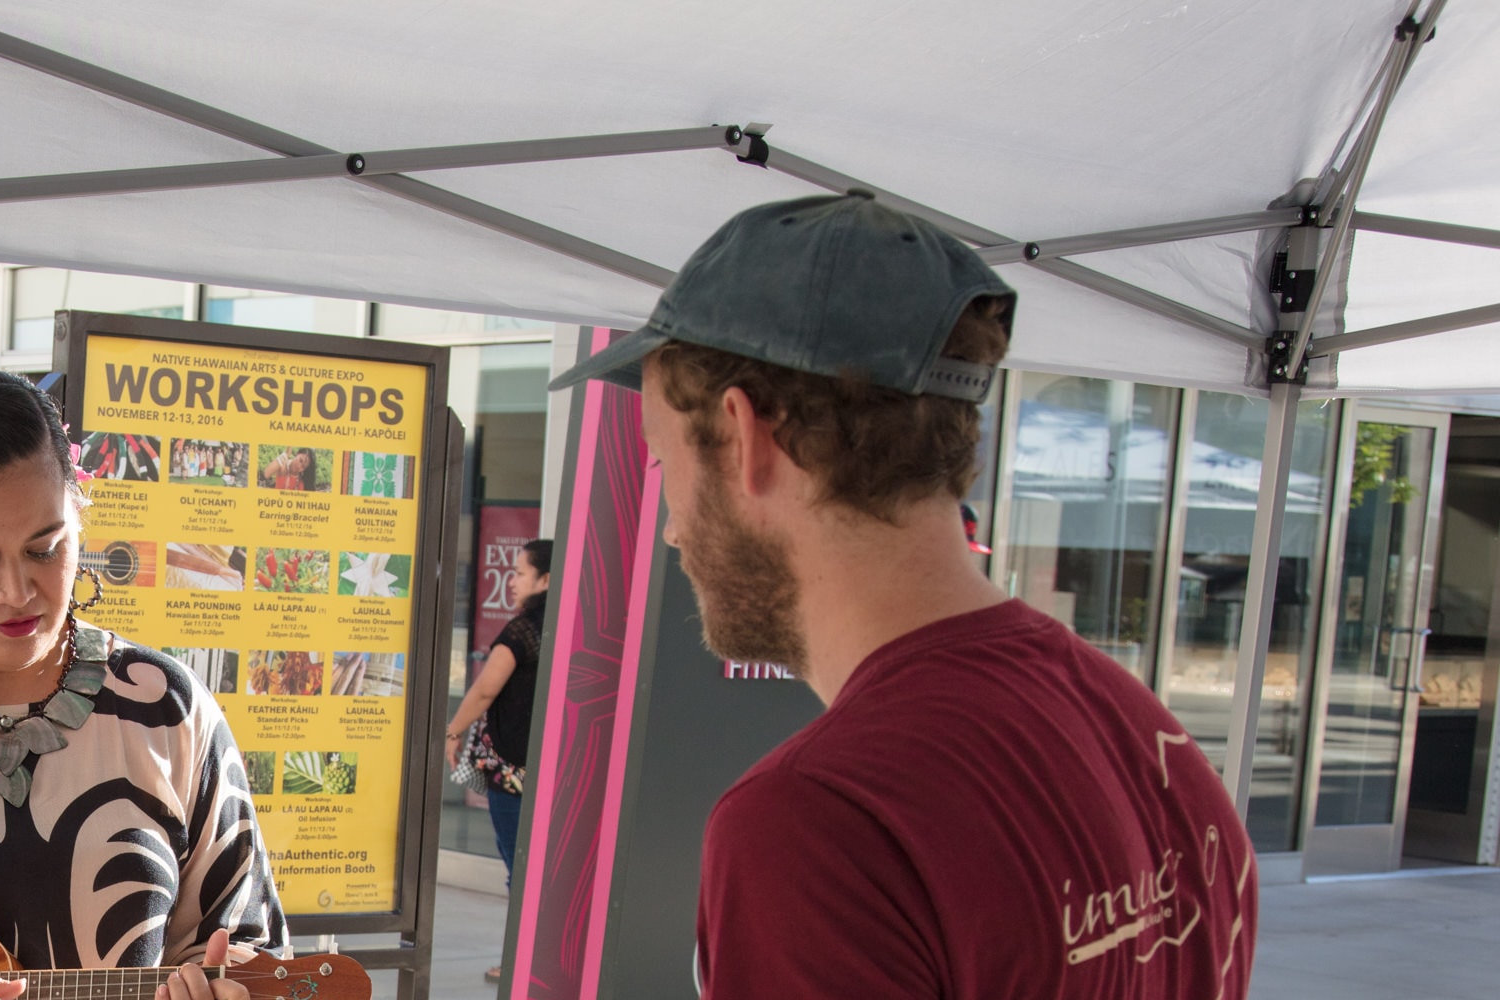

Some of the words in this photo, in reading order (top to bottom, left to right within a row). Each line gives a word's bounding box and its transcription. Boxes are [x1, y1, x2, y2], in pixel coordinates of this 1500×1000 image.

[152, 353, 190, 366] NATIVE
[193, 358, 248, 371] HAWAIIAN
[250, 362, 276, 374] ARTS
[279, 365, 286, 375] &
[290, 366, 334, 379] CULTURE
[337, 370, 364, 381] EXPO
[105, 363, 404, 425] WORKSHOPS
[98, 407, 159, 421] NOVEMBER
[163, 412, 195, 425] 12-13,
[198, 415, 224, 426] 2016
[270, 420, 283, 431] KA
[286, 422, 332, 435] MAKANA
[90, 490, 131, 501] FEATHER
[134, 493, 148, 501] LEI
[180, 496, 195, 505] OLI
[198, 498, 236, 509] (CHANT)
[286, 501, 293, 509] O
[354, 506, 398, 516] HAWAIIAN
[355, 518, 396, 528] QUILTING
[484, 543, 522, 567] EXT
[166, 600, 191, 610] KAPA
[193, 601, 241, 612] POUNDING
[353, 607, 391, 616] LAUHALA
[248, 706, 287, 714] FEATHER
[346, 707, 385, 715] LAUHALA
[268, 849, 368, 862] haAuthentic.org
[279, 864, 341, 875] Information
[345, 864, 375, 873] Booth
